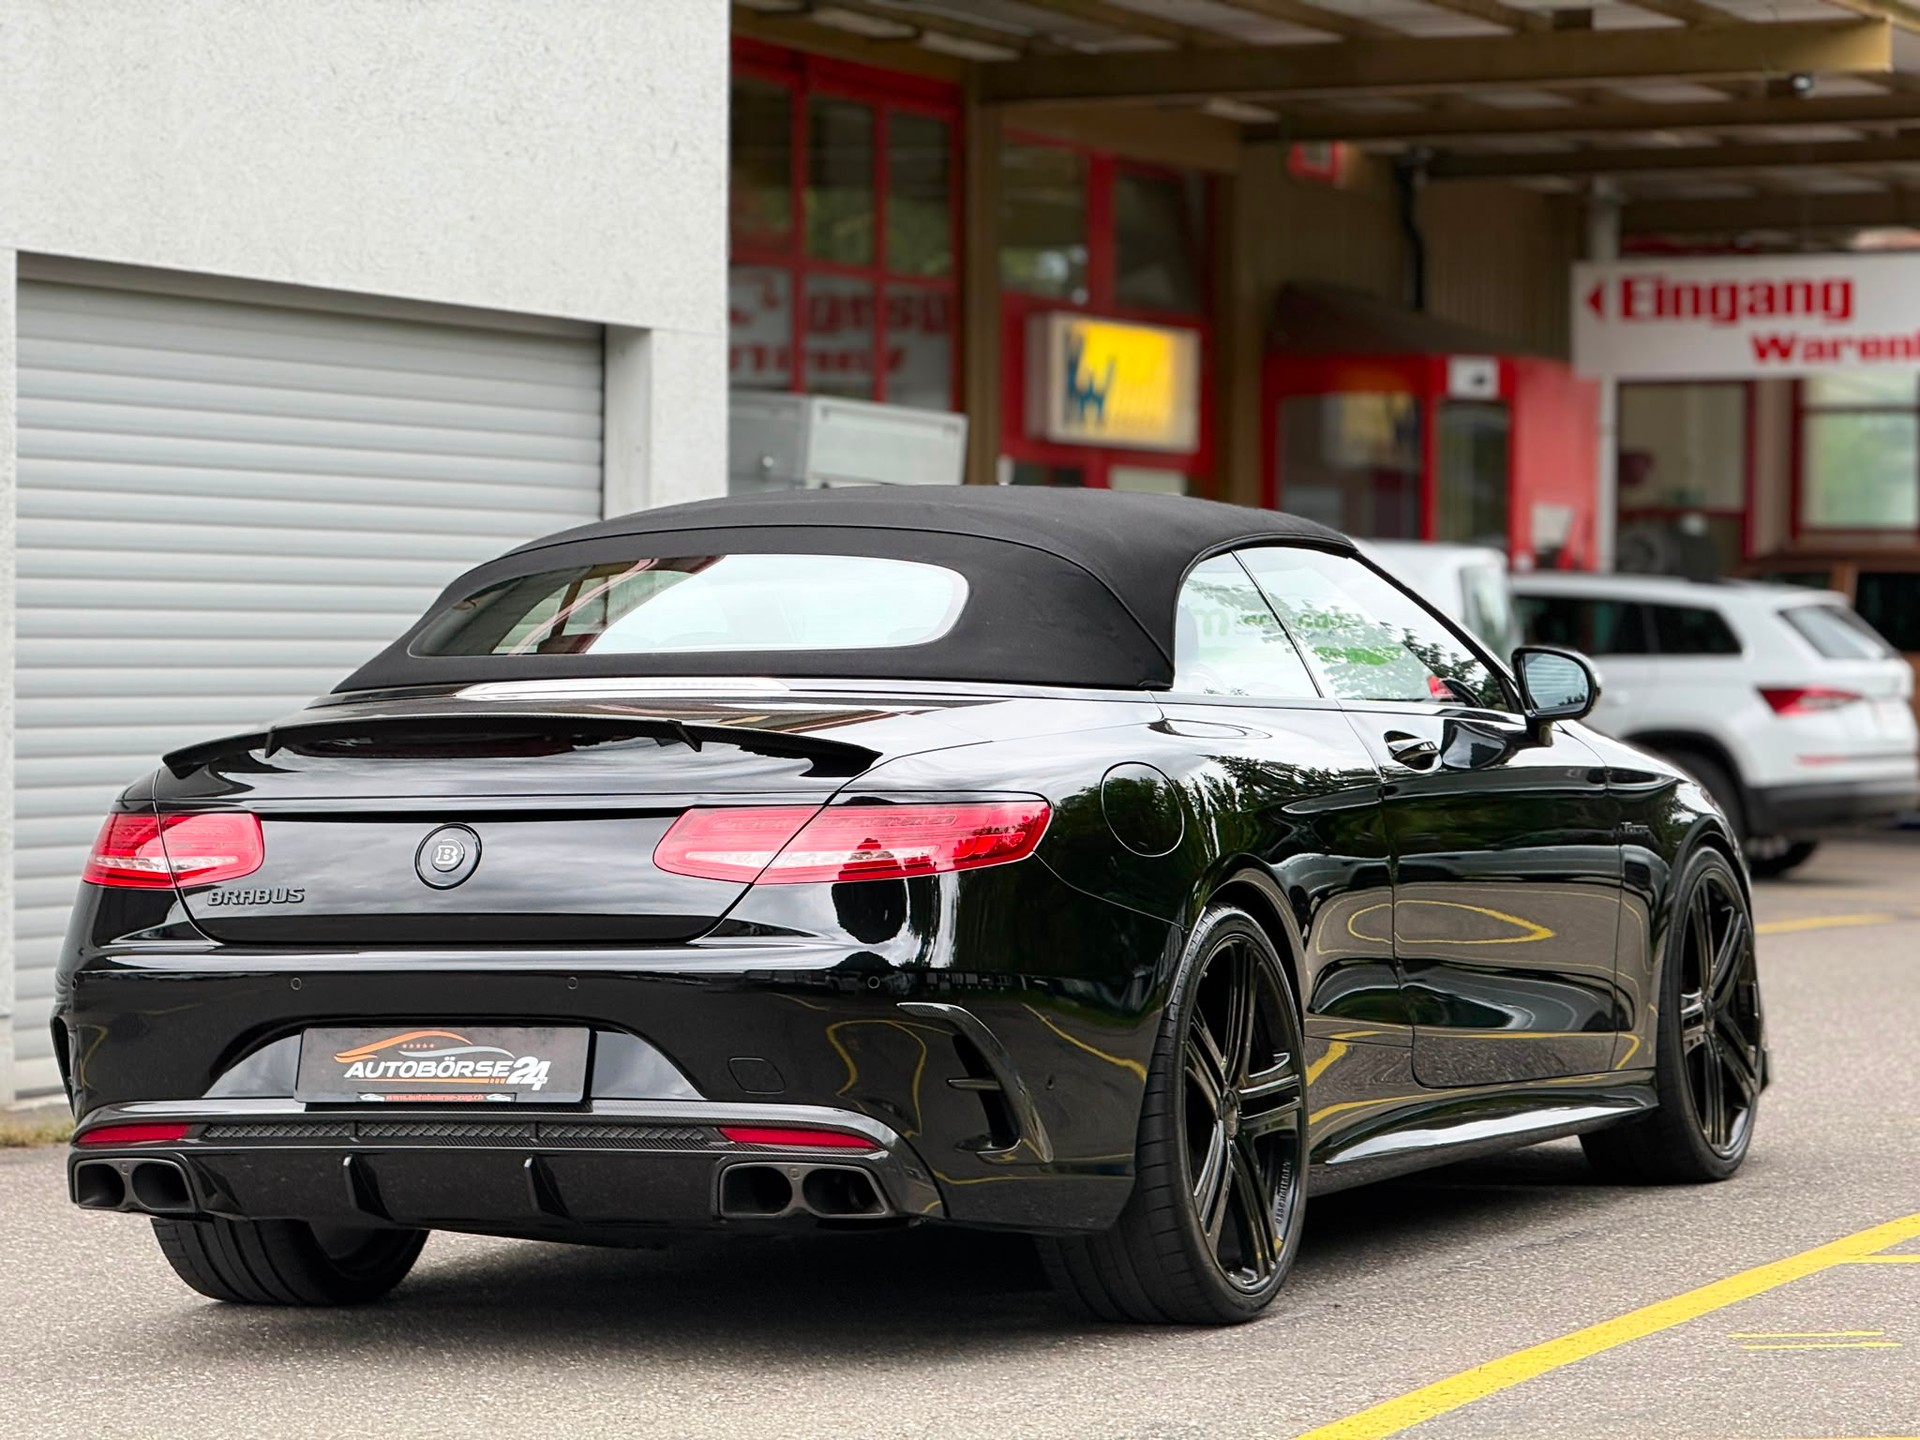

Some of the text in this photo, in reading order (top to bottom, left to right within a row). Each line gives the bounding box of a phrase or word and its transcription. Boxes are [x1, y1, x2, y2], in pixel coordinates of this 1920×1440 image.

[1620, 275, 1855, 325] Eingang
[435, 845, 458, 864] B
[207, 887, 305, 906] BRABUS
